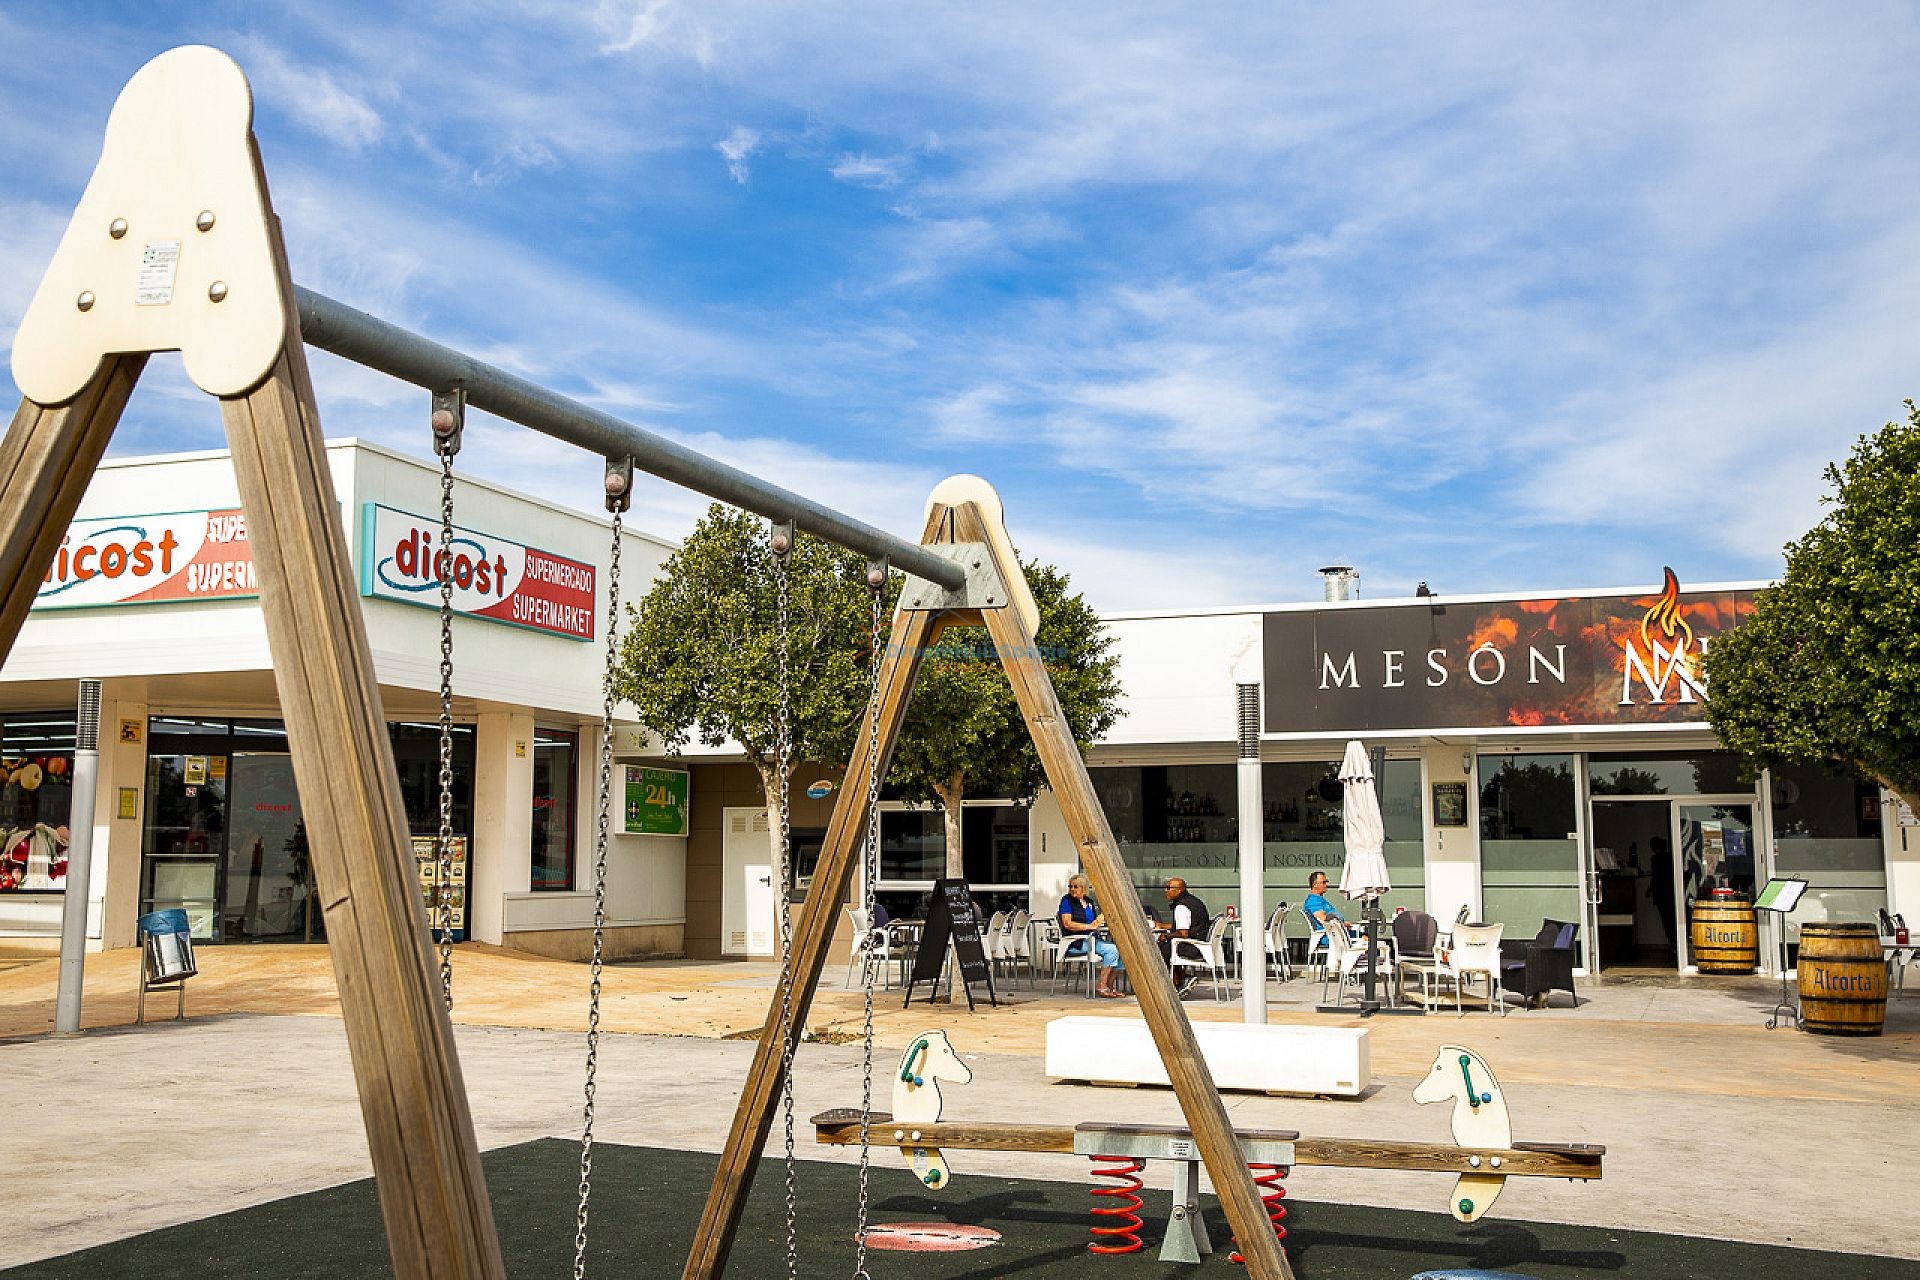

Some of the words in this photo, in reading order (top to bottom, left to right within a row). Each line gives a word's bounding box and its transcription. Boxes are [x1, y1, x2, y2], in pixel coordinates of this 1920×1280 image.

[44, 529, 178, 582] icost
[396, 528, 508, 597] dicost
[526, 555, 592, 593] SUPERMERCADO
[513, 594, 592, 634] SUPERMARKET
[1318, 641, 1567, 689] MESÓN
[644, 784, 676, 808] 24h
[1703, 927, 1747, 943] Alcorta
[1814, 967, 1872, 992] Alcorta
